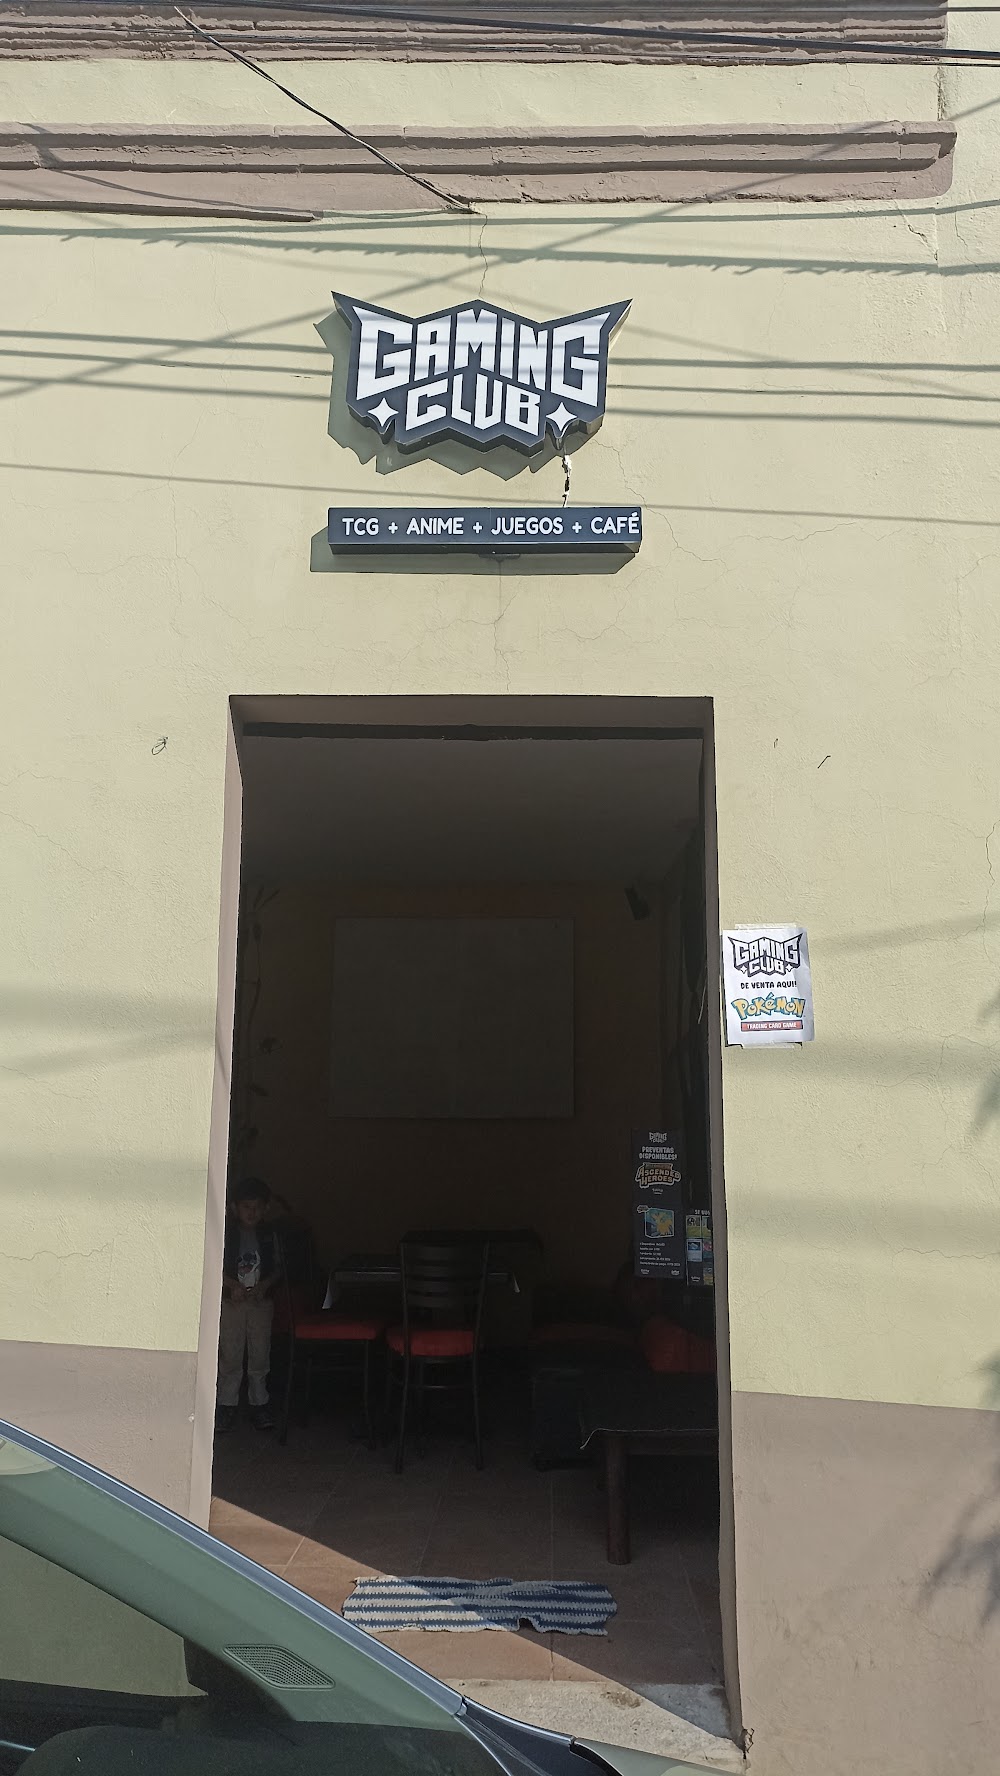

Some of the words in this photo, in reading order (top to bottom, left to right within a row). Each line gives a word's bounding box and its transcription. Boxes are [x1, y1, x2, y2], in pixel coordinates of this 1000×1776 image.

[352, 306, 611, 407] GAMING
[405, 373, 541, 436] CLUB
[342, 517, 379, 536] TCG
[406, 517, 464, 535] ANIME
[491, 516, 563, 535] JUEGOS
[590, 511, 640, 535] CAFÉ
[731, 936, 799, 966] GAMING
[749, 956, 785, 975] CLUB
[751, 981, 775, 989] VENTA
[776, 980, 797, 988] AQUI!
[641, 1146, 675, 1154] PREVENTAS
[641, 1175, 673, 1185] HEROES
